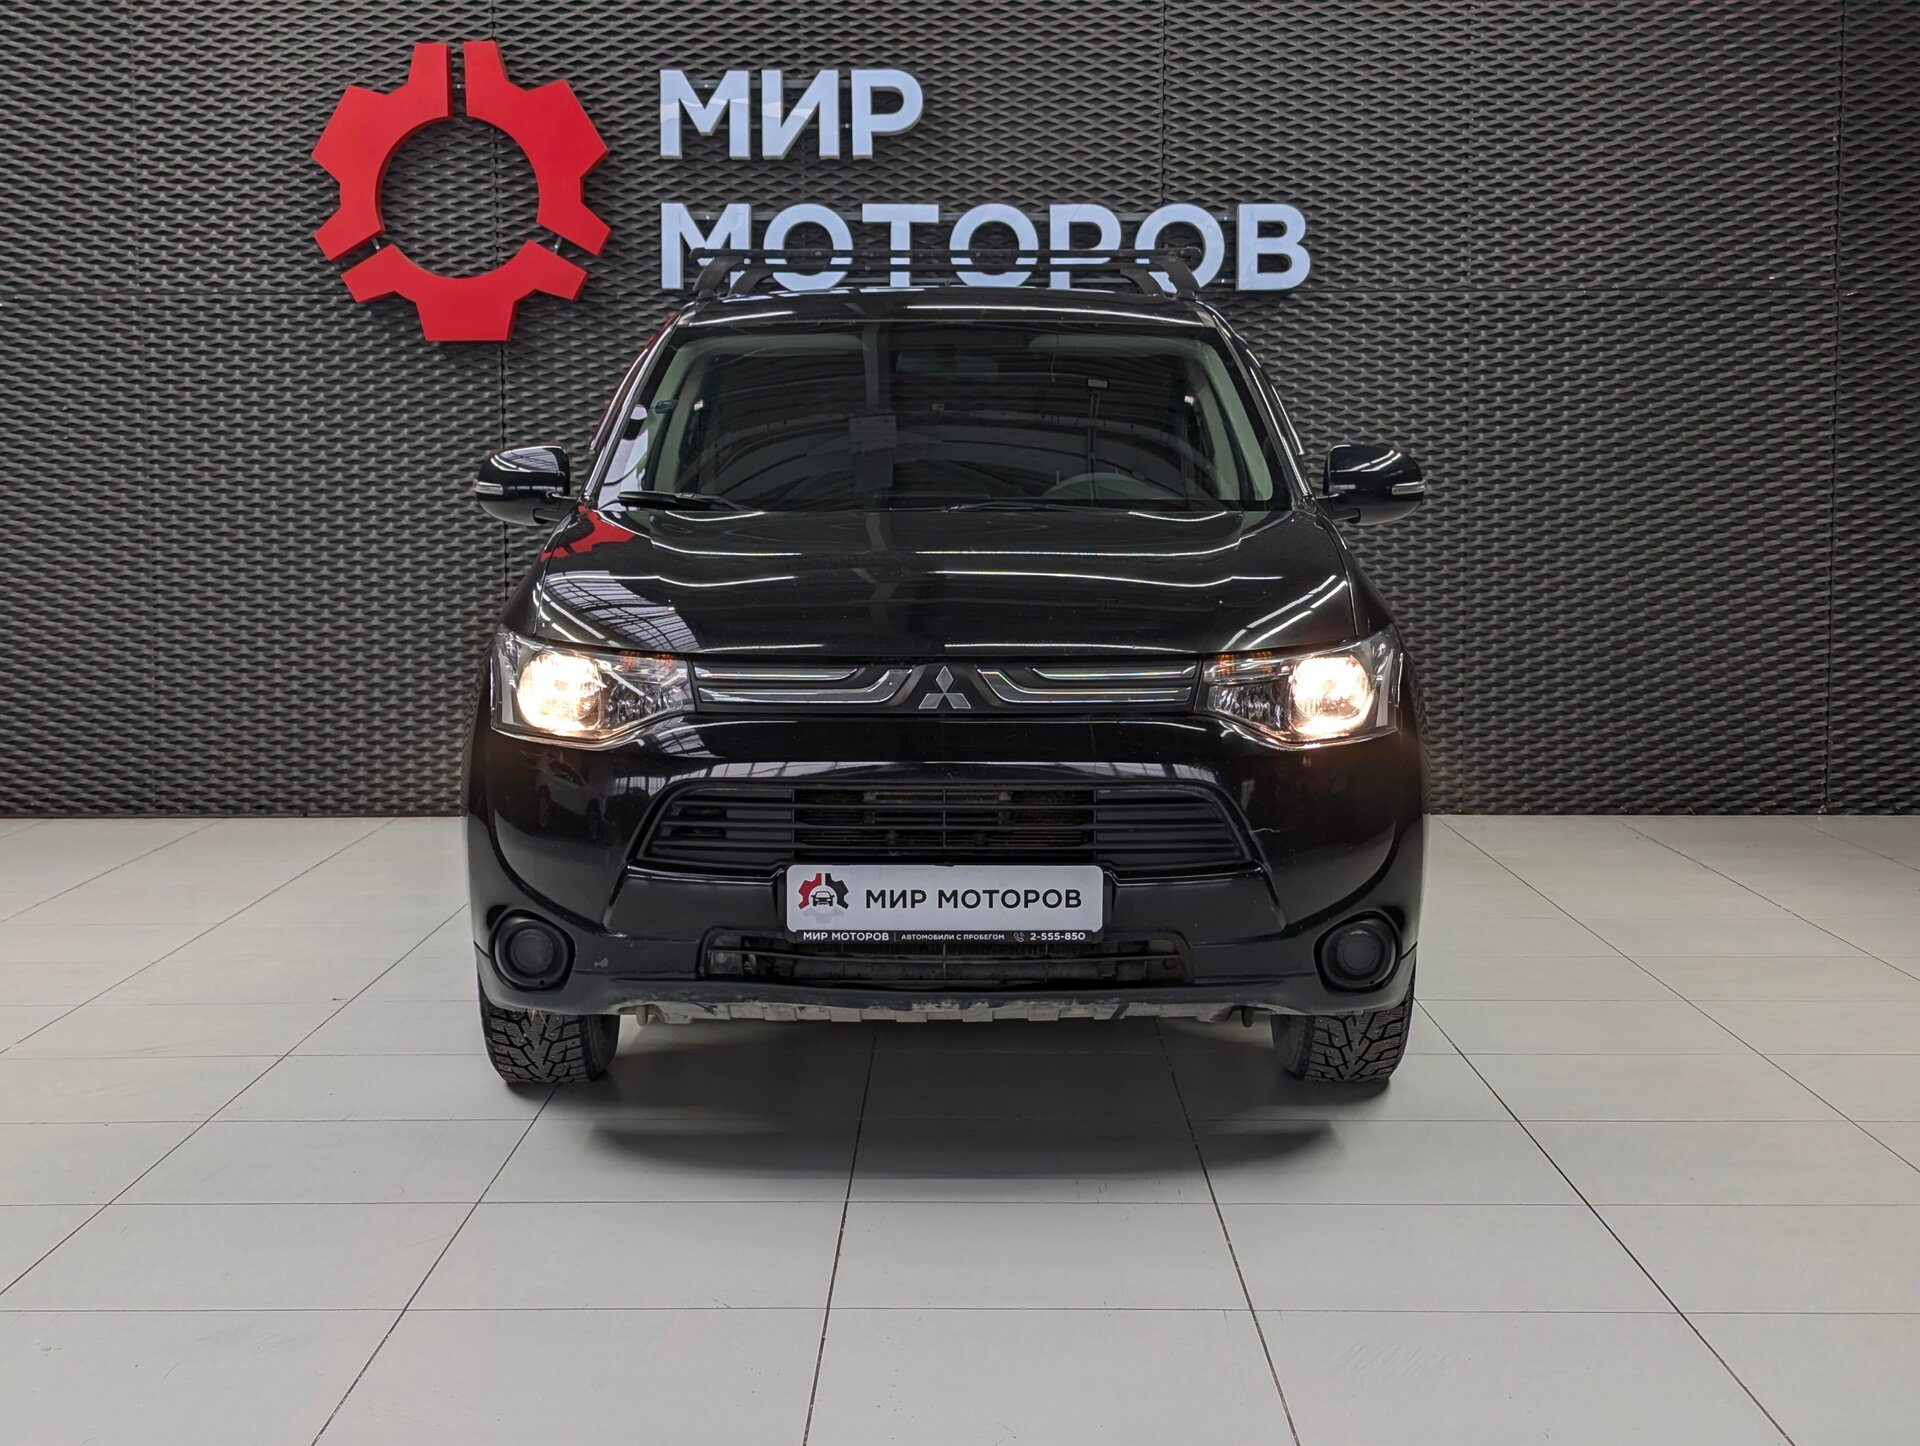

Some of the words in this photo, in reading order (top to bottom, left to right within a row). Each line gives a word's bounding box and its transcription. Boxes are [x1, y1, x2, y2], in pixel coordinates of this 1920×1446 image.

[660, 69, 923, 160] МИР
[660, 202, 1312, 292] МОТОРОВ
[865, 889, 927, 909] МИР
[937, 889, 1082, 909] МОТОРОВ
[803, 932, 828, 941] МИР
[831, 932, 890, 941] МОТОРОВ
[1030, 932, 1086, 941] 2-555-850
